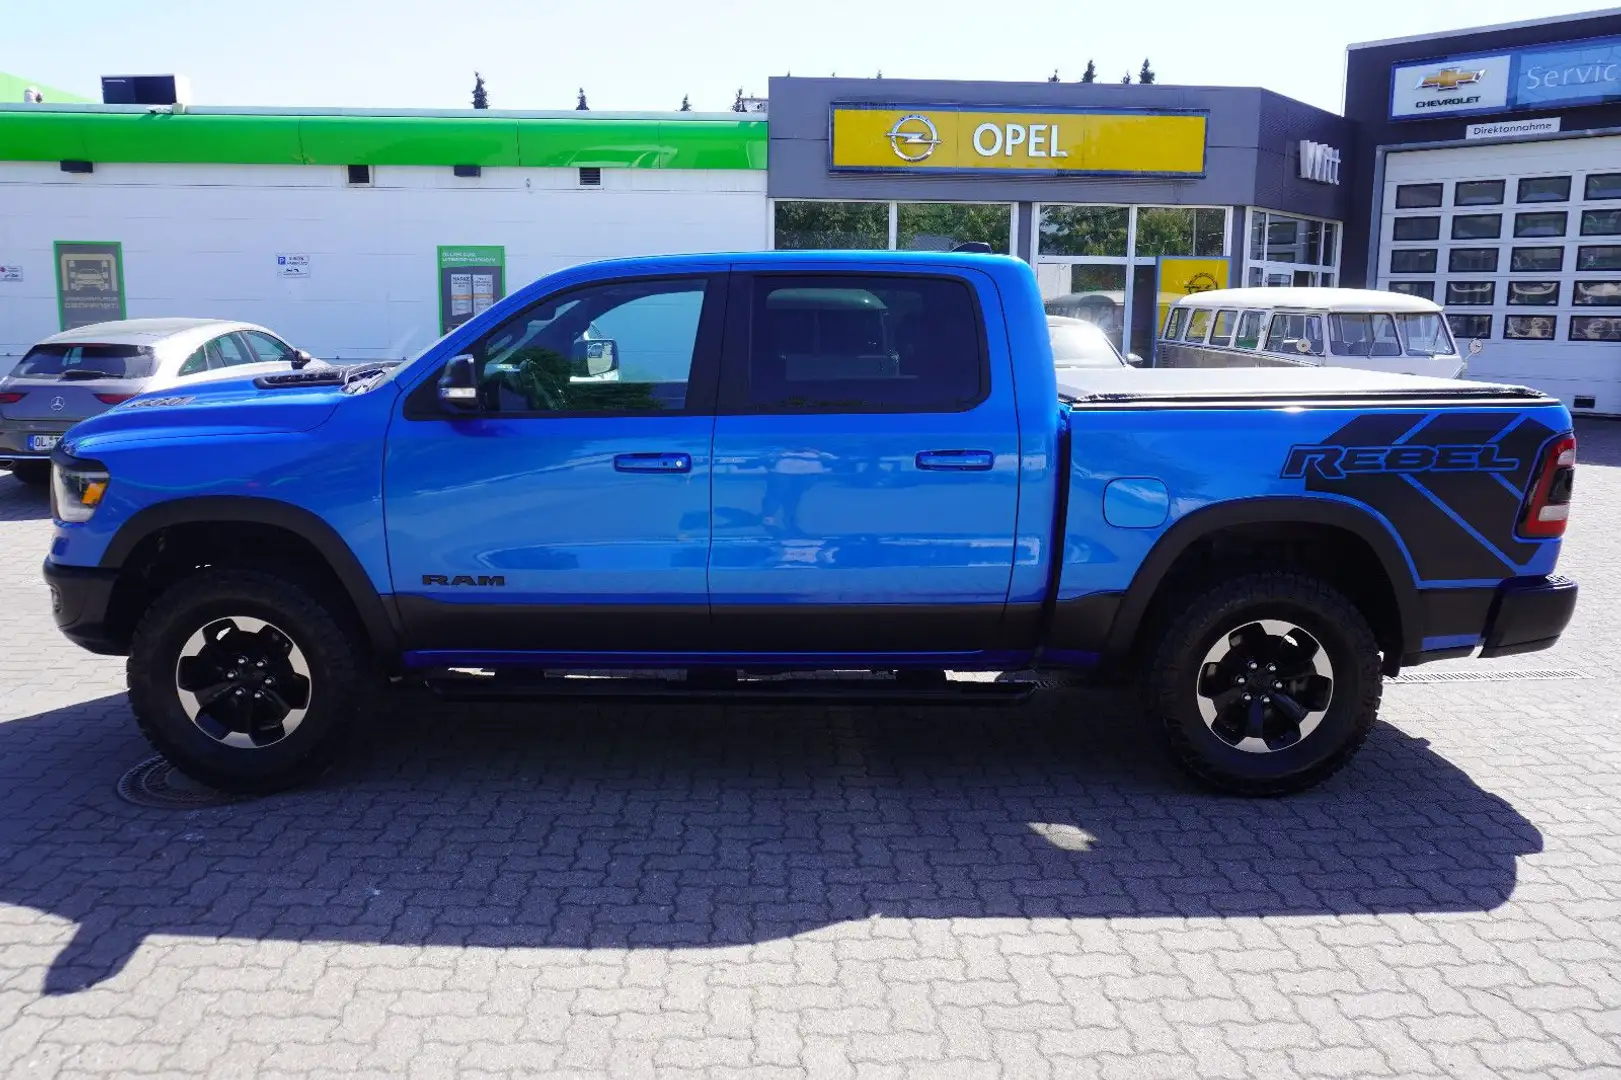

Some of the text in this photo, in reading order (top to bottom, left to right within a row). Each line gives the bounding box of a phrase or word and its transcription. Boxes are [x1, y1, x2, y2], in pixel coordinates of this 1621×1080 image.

[1415, 95, 1481, 109] CHEVROLET
[972, 122, 1069, 157] OPEL
[1473, 121, 1552, 136] Direktannahme
[1300, 139, 1341, 186] Witt
[1279, 443, 1520, 480] REBEL
[421, 574, 506, 586] RAM
